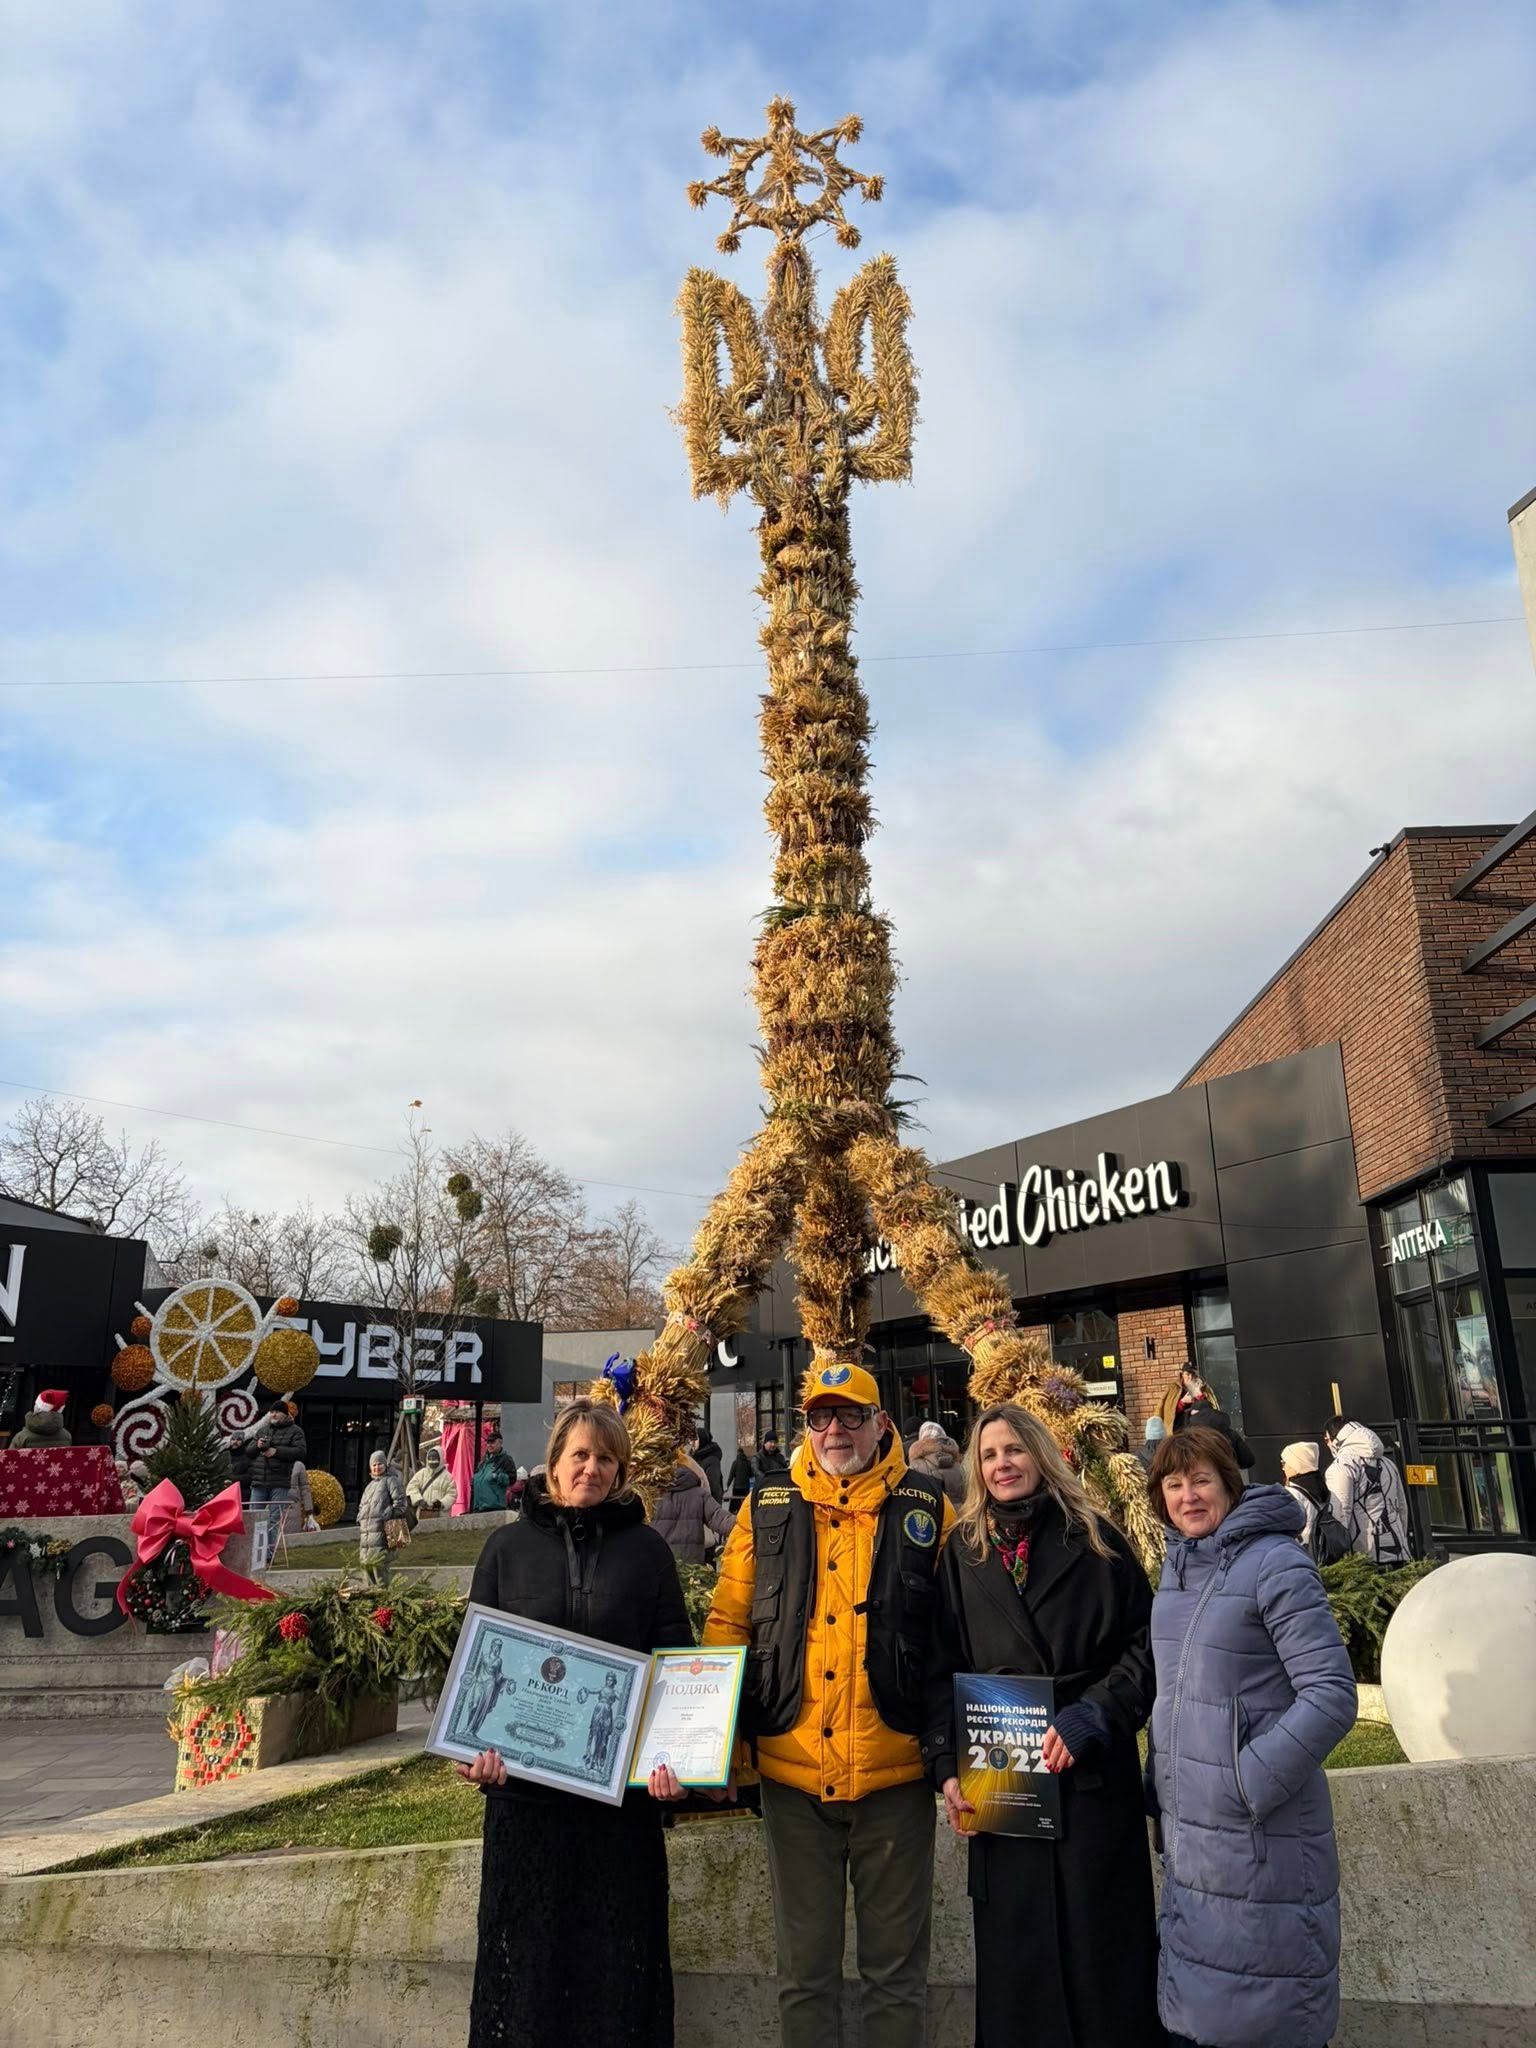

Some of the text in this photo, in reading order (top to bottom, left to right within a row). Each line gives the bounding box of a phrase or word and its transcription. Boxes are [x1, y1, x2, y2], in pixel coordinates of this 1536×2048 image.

[959, 1183, 1009, 1248] ied
[1017, 1152, 1178, 1245] Chicken
[1391, 1219, 1447, 1263] АПТЕКА
[270, 1317, 483, 1383] YBER
[528, 1678, 569, 1699] РЕКОРД
[665, 1683, 720, 1696] ПОДЯКА
[966, 1703, 1047, 1716] НАЦІОНАЛЬНИЙ
[1002, 1717, 1048, 1728] РЕКОРДІВ
